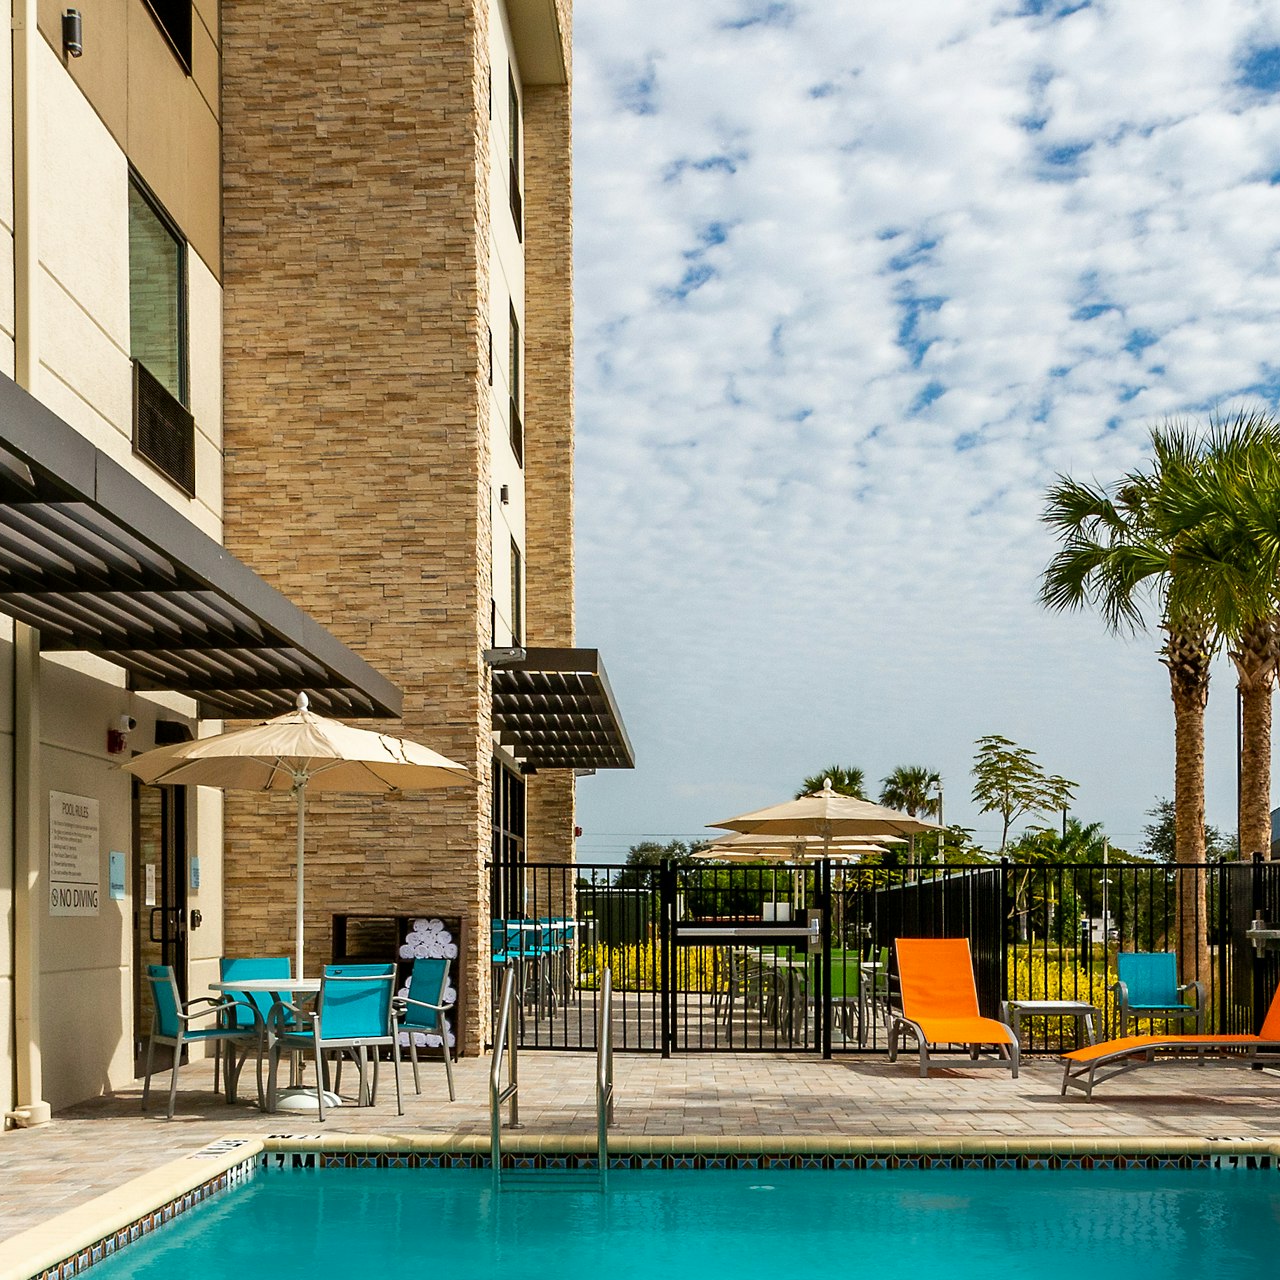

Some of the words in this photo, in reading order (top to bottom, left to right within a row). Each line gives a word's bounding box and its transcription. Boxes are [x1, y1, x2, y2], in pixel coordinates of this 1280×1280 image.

[62, 802, 76, 816] POOL
[76, 805, 89, 819] RULES
[60, 888, 72, 907] NO
[73, 889, 98, 908] DIVING
